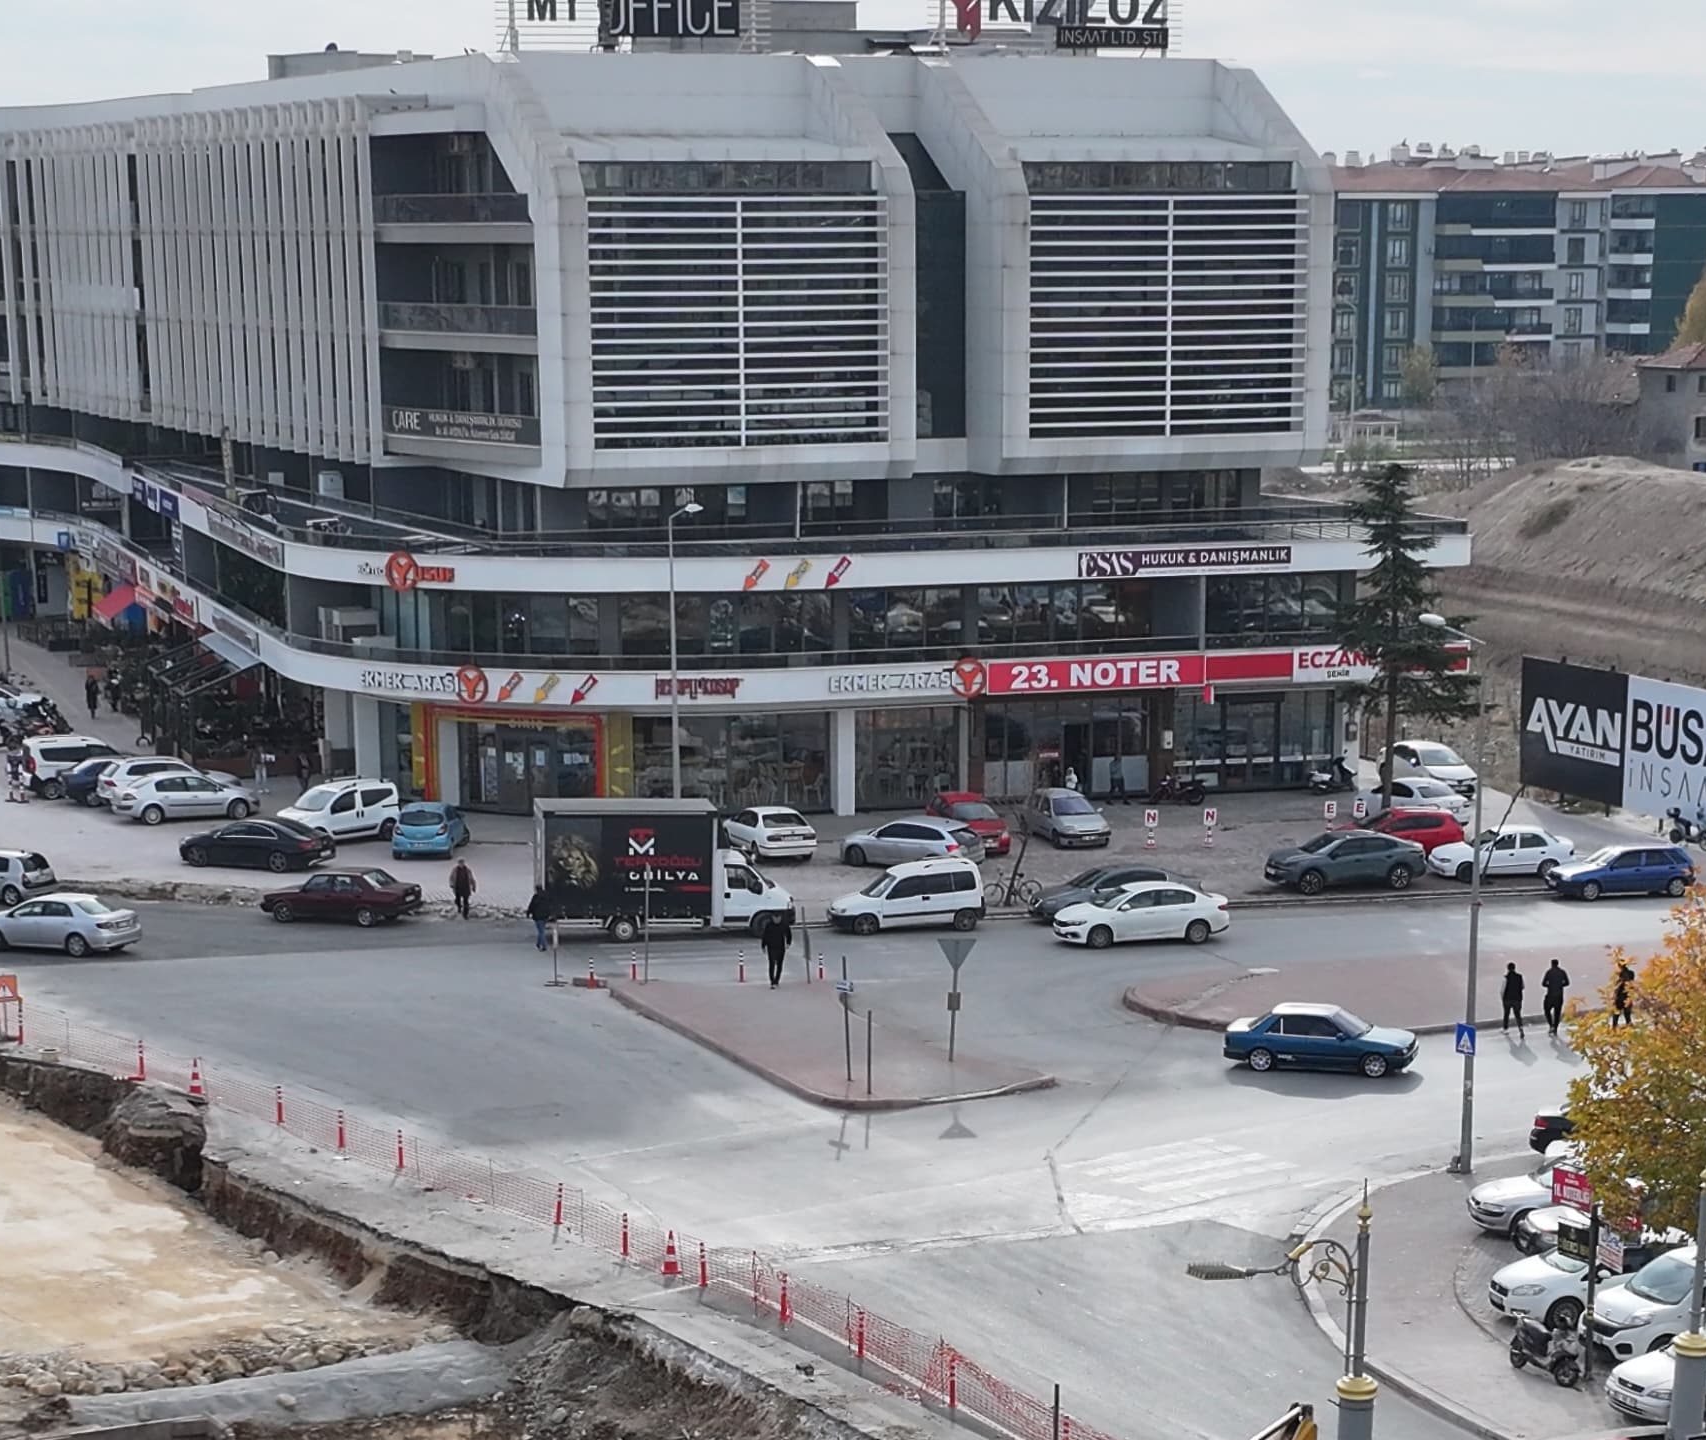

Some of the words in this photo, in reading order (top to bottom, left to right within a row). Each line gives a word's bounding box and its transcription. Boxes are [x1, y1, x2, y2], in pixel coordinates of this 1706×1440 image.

[1141, 553, 1185, 566] HUKUK
[1200, 549, 1288, 566] DANIŞMANLIK
[828, 674, 889, 693] EKMEK
[1010, 664, 1059, 689] 23.
[1069, 659, 1181, 687] NOTER
[1526, 697, 1622, 754] AYAN
[1568, 745, 1606, 761] YATIRIM
